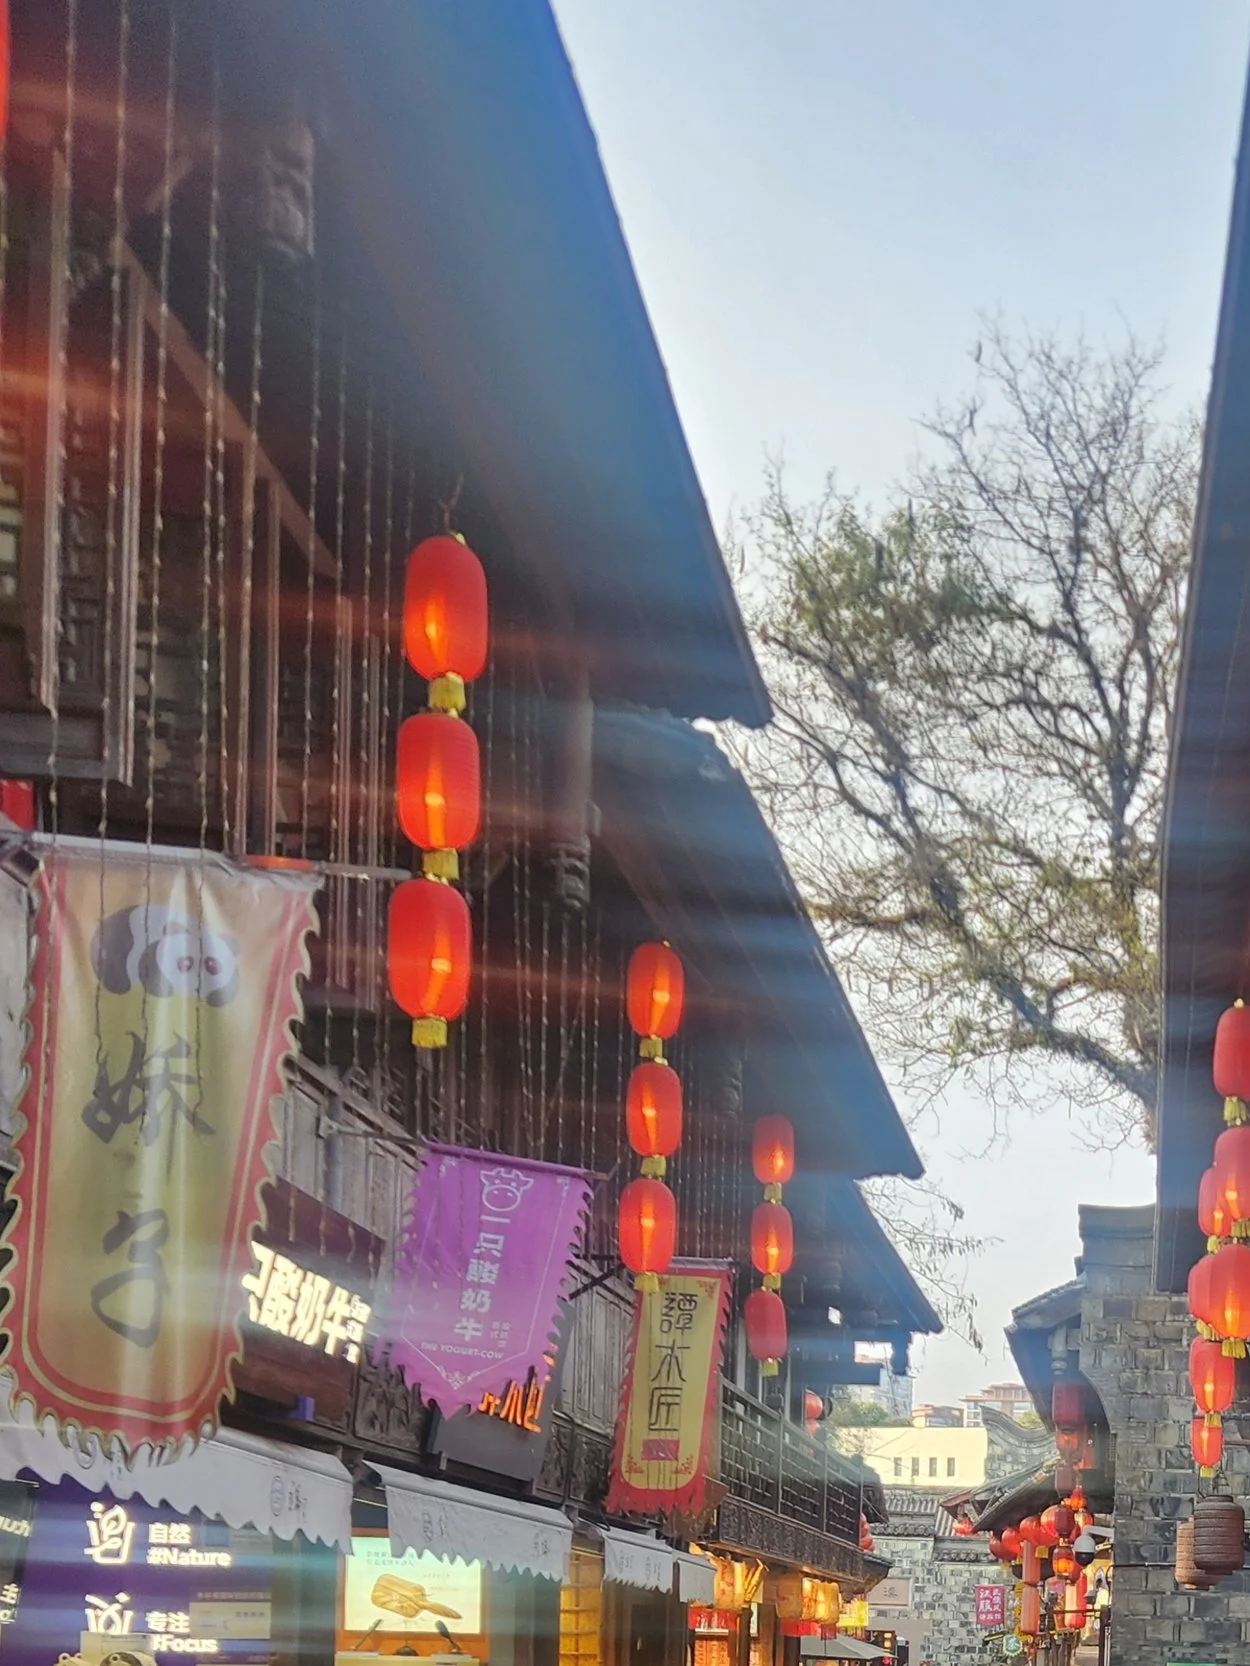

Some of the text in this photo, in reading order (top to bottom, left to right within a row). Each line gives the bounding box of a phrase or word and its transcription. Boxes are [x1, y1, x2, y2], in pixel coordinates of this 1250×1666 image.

[454, 1215, 510, 1342] 一只酸奶牛
[148, 1522, 191, 1544] 自然
[146, 1547, 232, 1567] #Nature
[145, 1611, 191, 1633] 专注
